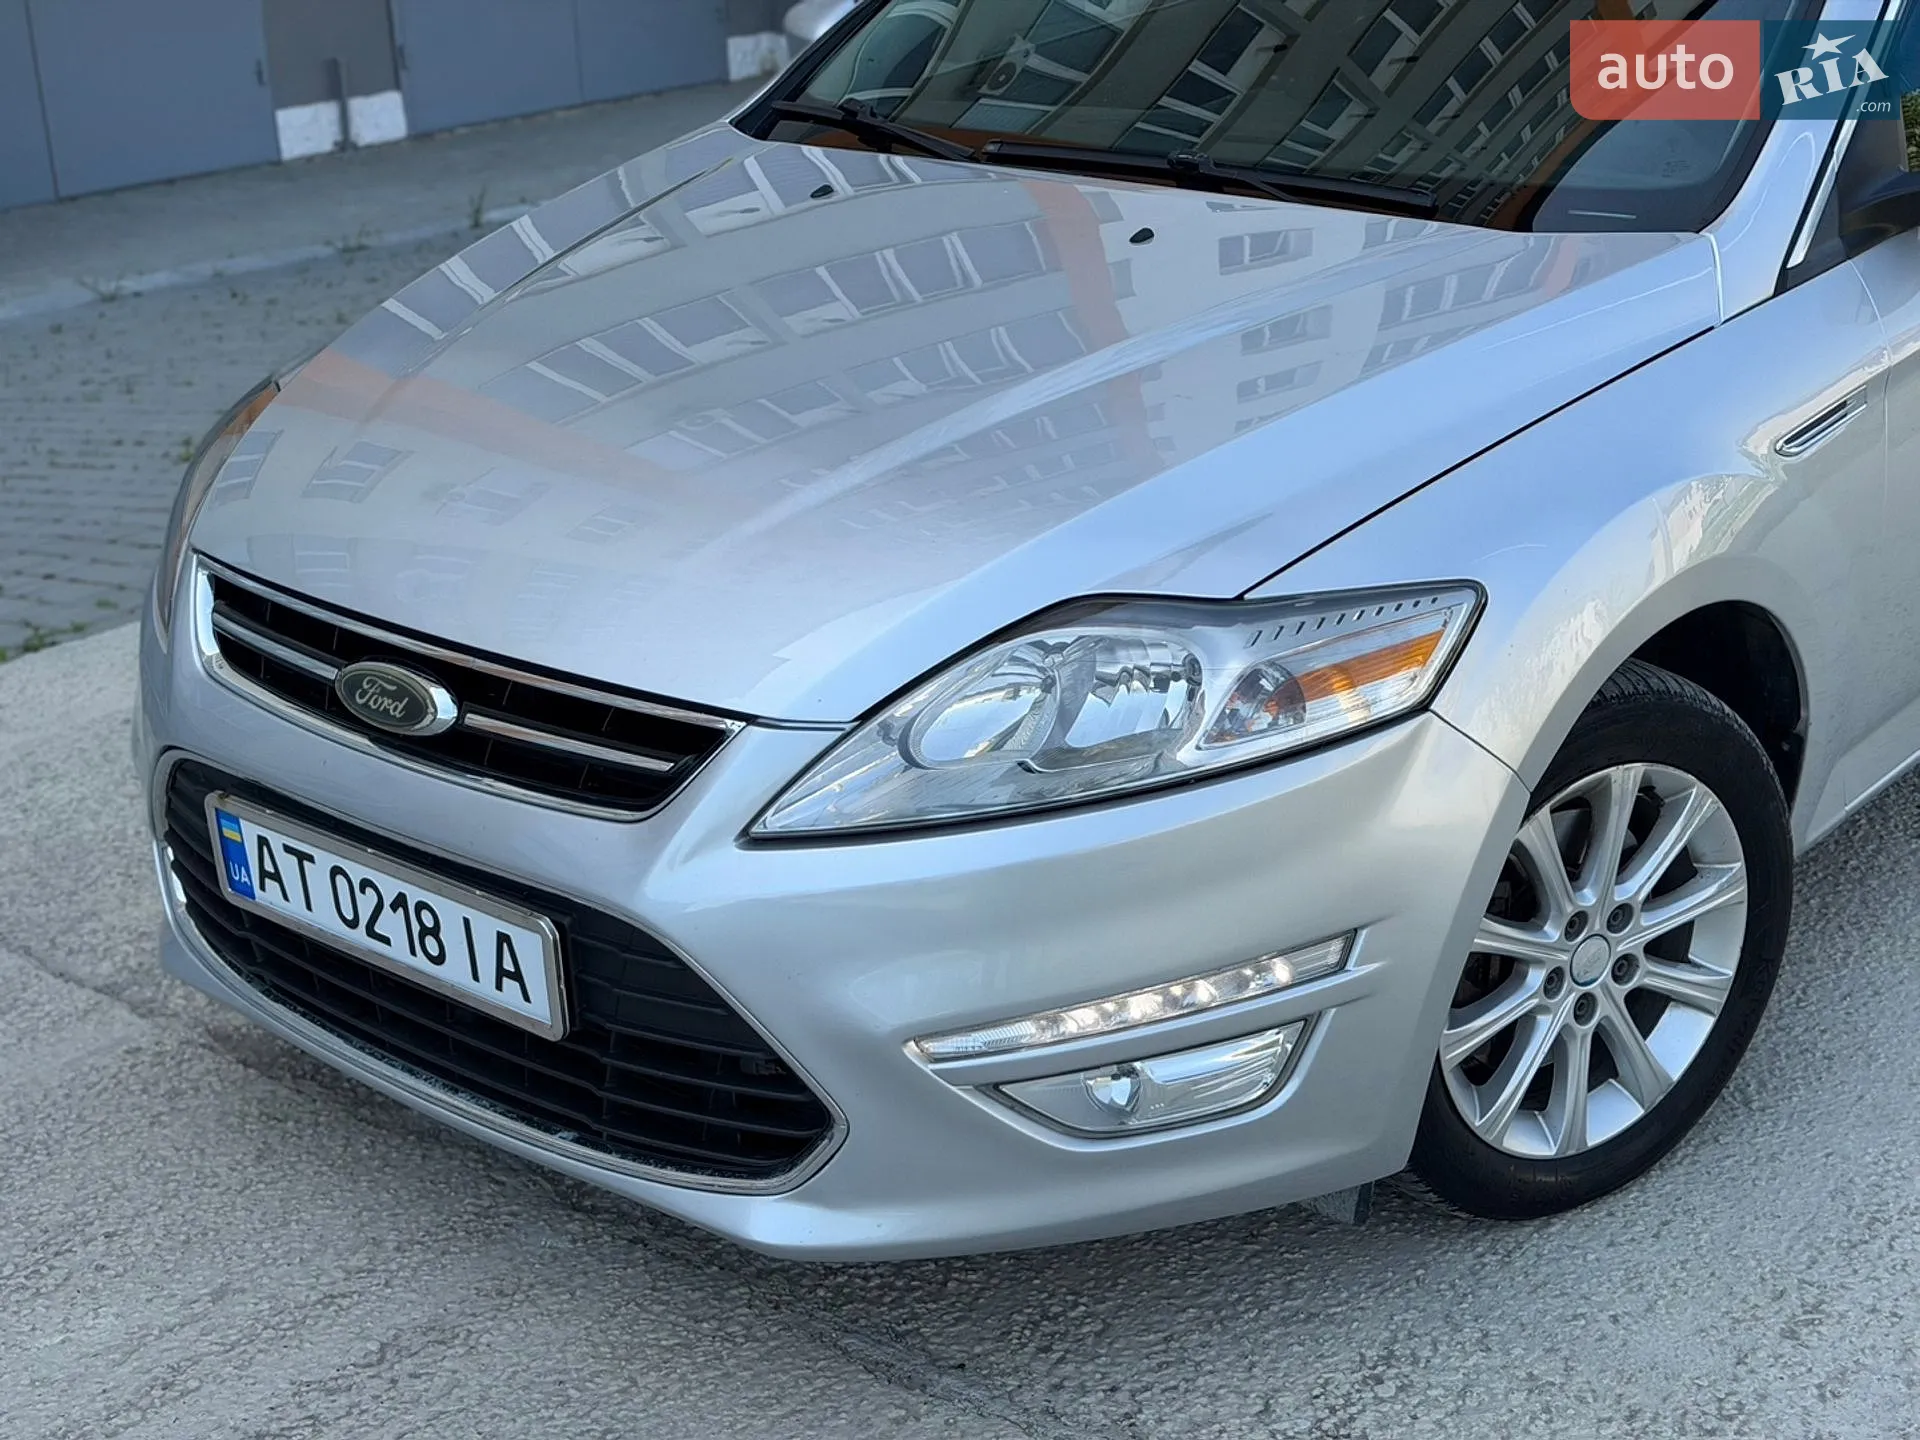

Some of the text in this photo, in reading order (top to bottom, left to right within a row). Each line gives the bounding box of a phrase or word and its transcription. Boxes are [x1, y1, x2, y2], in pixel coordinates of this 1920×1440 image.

[355, 676, 409, 718] Ford
[229, 863, 251, 887] UA
[256, 834, 532, 1004] AT 0218 IA
